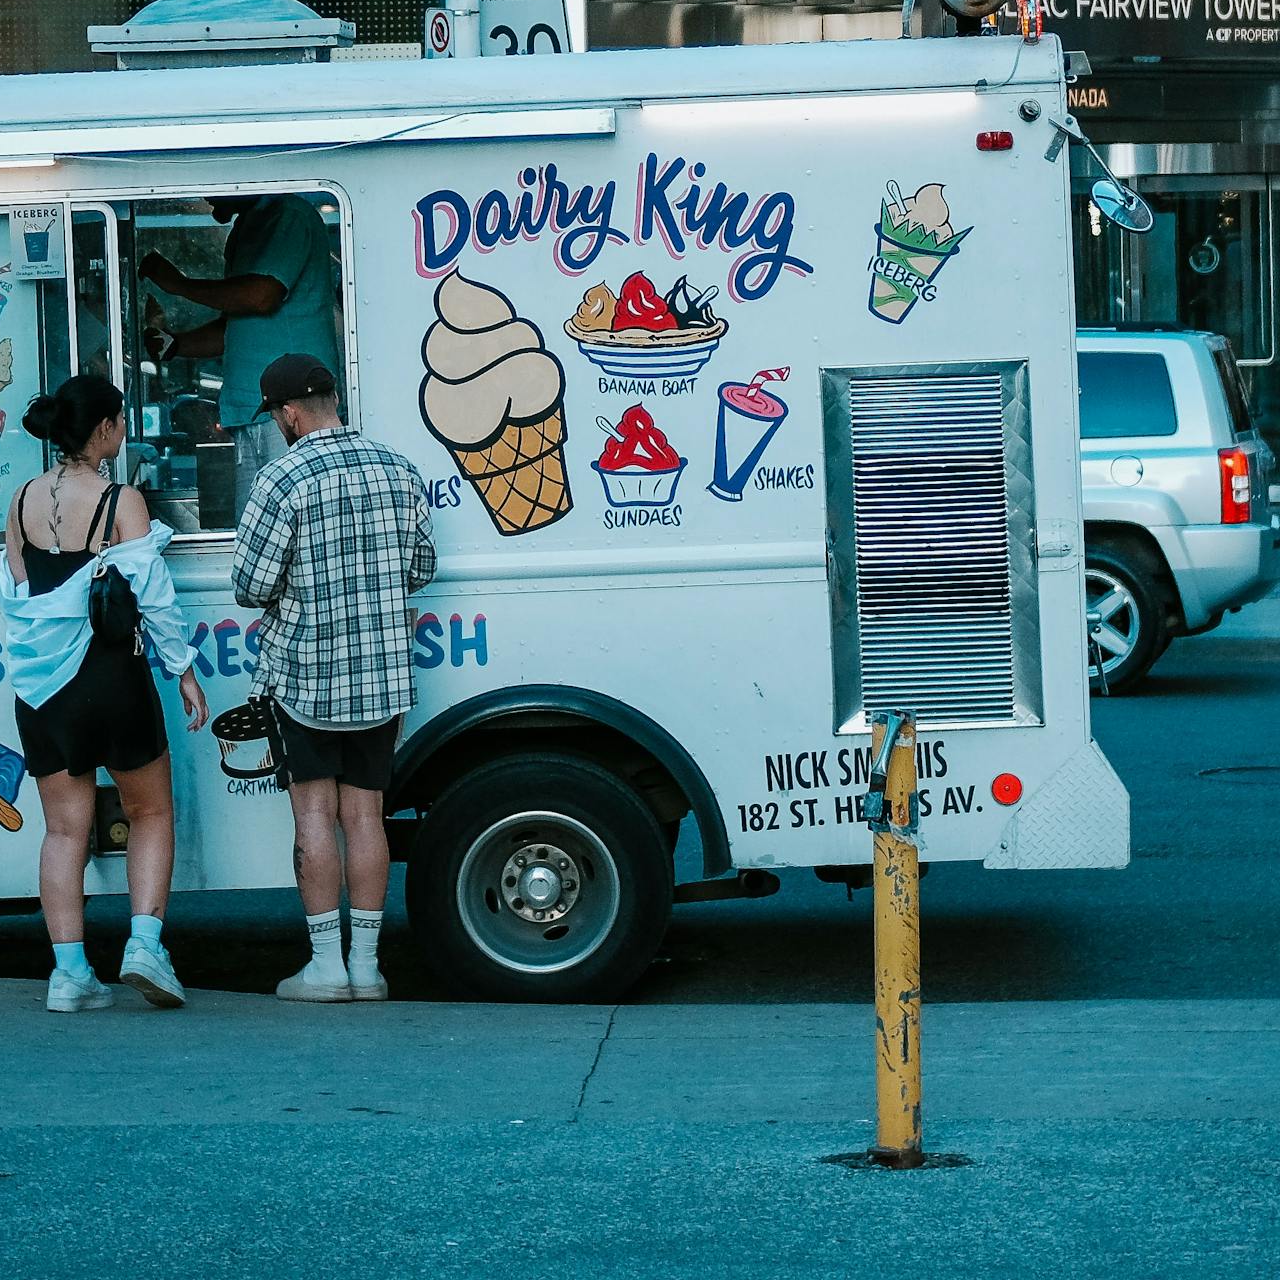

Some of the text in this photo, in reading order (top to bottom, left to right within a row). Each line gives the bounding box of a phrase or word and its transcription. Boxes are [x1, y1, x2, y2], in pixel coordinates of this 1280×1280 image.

[1206, 28, 1214, 41] A
[1068, 88, 1108, 108] NADA
[13, 208, 58, 219] ICEBERG
[412, 153, 814, 303] Dairy King
[867, 256, 938, 303] ICEBERG
[599, 377, 699, 396] BANANA BOAT
[754, 465, 815, 491] SHAKES
[603, 508, 683, 530] SUNDAES
[765, 750, 830, 792] NICK
[737, 802, 780, 833] 182
[789, 798, 825, 829] ST.
[942, 785, 984, 816] AV.
